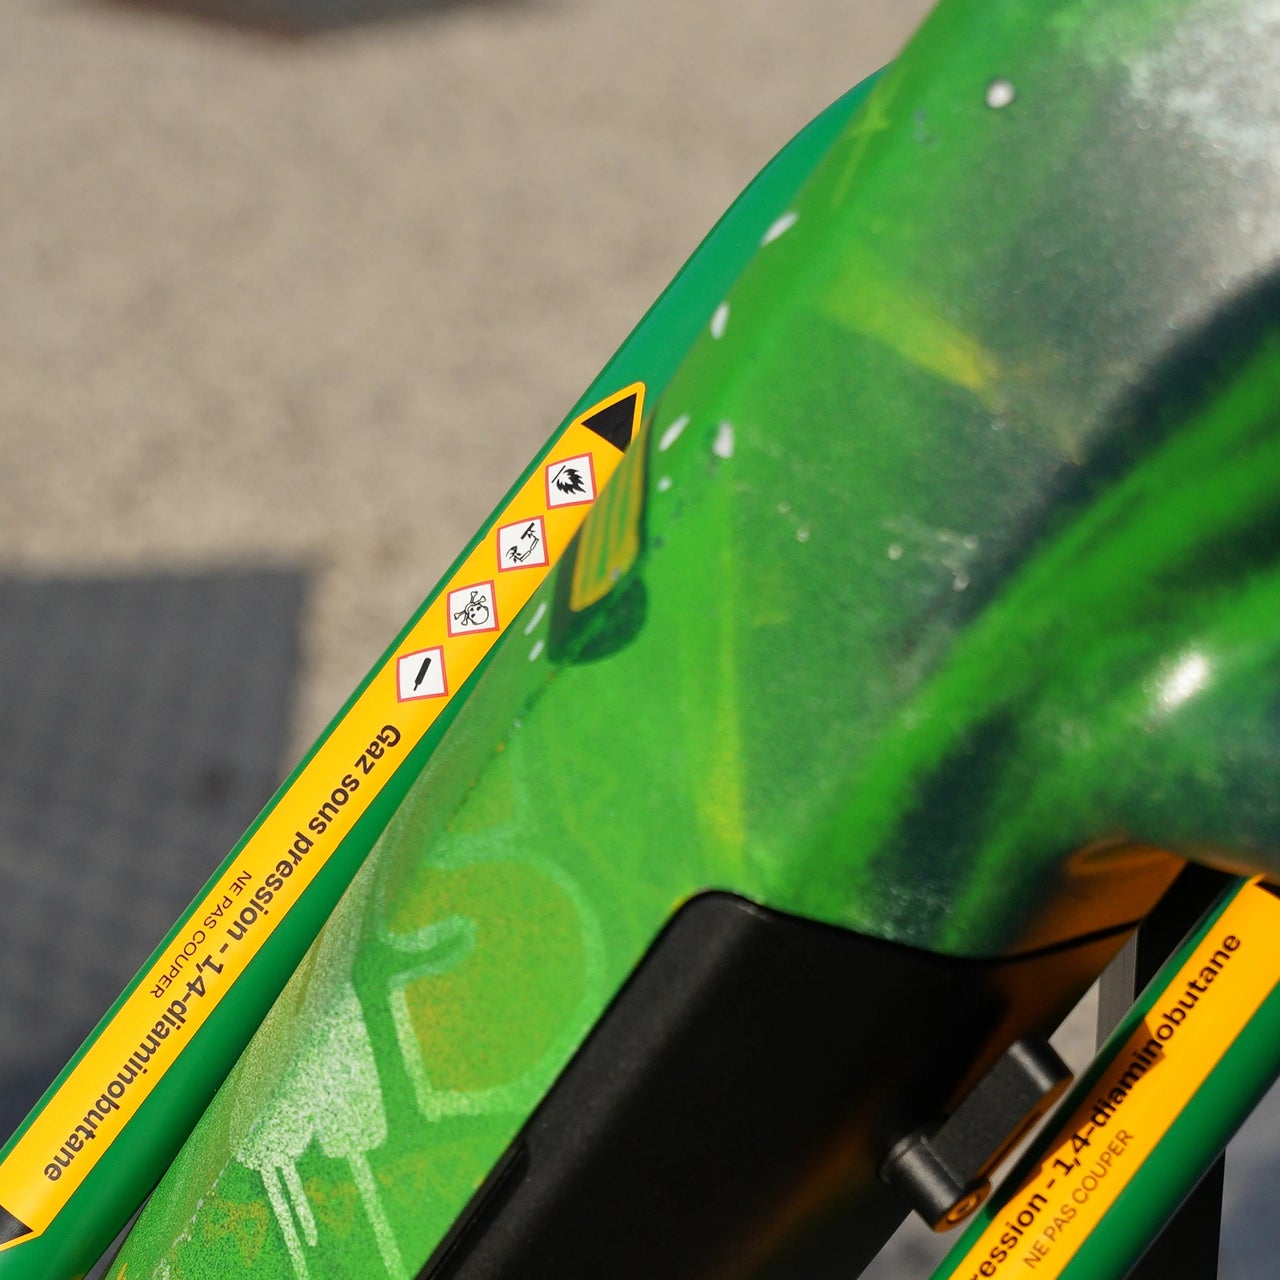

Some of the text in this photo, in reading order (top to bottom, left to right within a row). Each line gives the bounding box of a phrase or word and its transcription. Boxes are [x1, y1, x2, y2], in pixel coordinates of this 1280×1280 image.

[308, 773, 360, 836] sous
[355, 724, 402, 776] Gaz
[150, 869, 253, 999] NE PAS COUPER
[226, 831, 315, 941] pression
[44, 953, 226, 1182] 1,4-diaminobutane
[1052, 934, 1241, 1176] 1,4-diaminobutane
[1023, 1129, 1134, 1269] NE PAS COUPER
